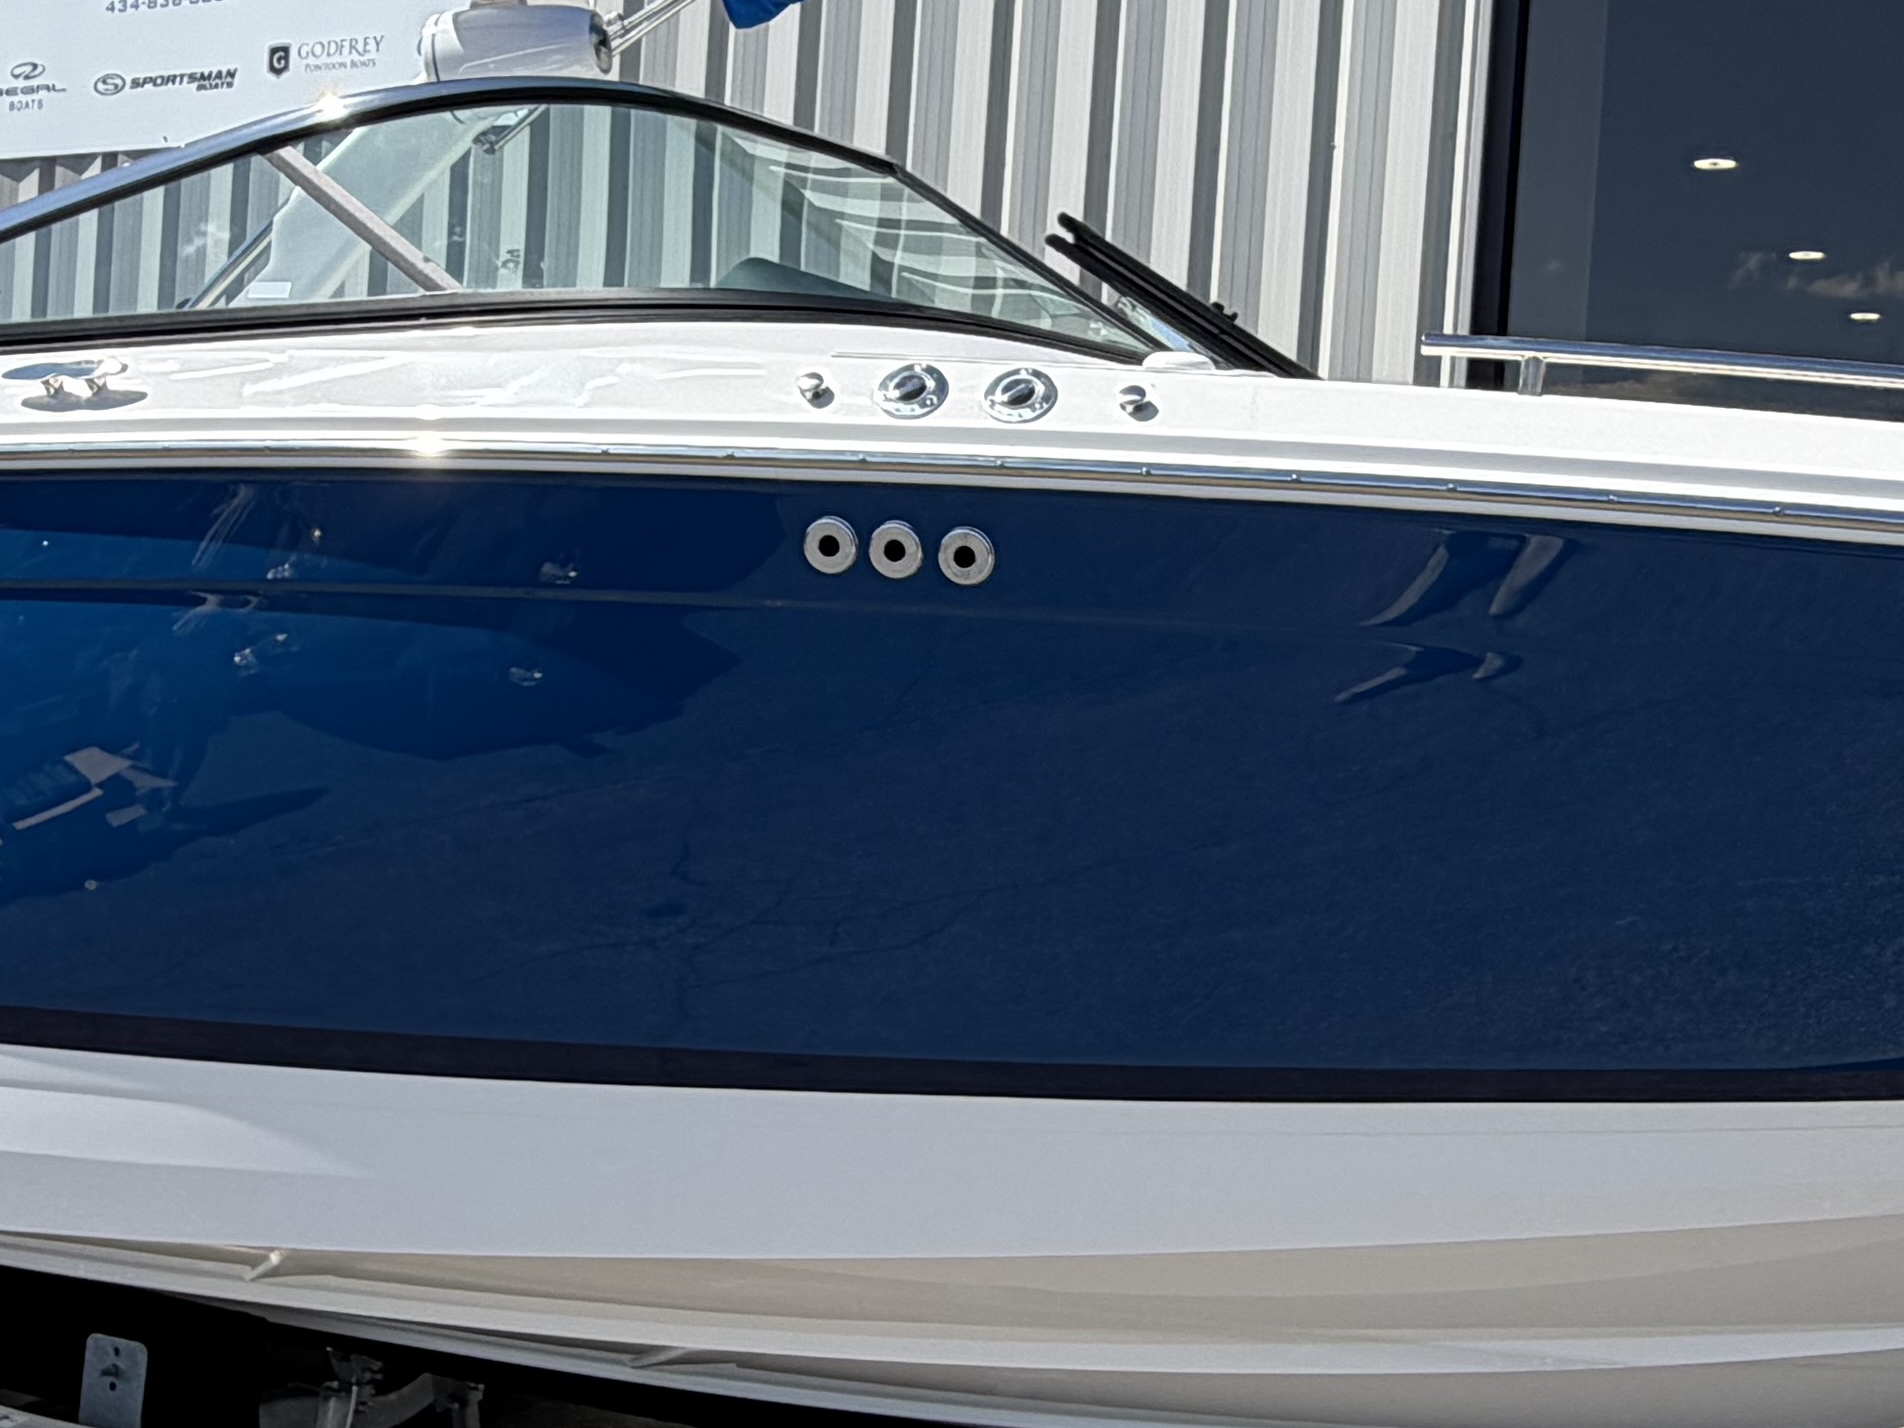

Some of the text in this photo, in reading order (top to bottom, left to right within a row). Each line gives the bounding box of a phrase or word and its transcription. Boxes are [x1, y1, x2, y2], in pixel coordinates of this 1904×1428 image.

[297, 34, 385, 61] GODFREY
[129, 67, 238, 90] SPORTSMAN
[9, 98, 44, 112] BOATS
